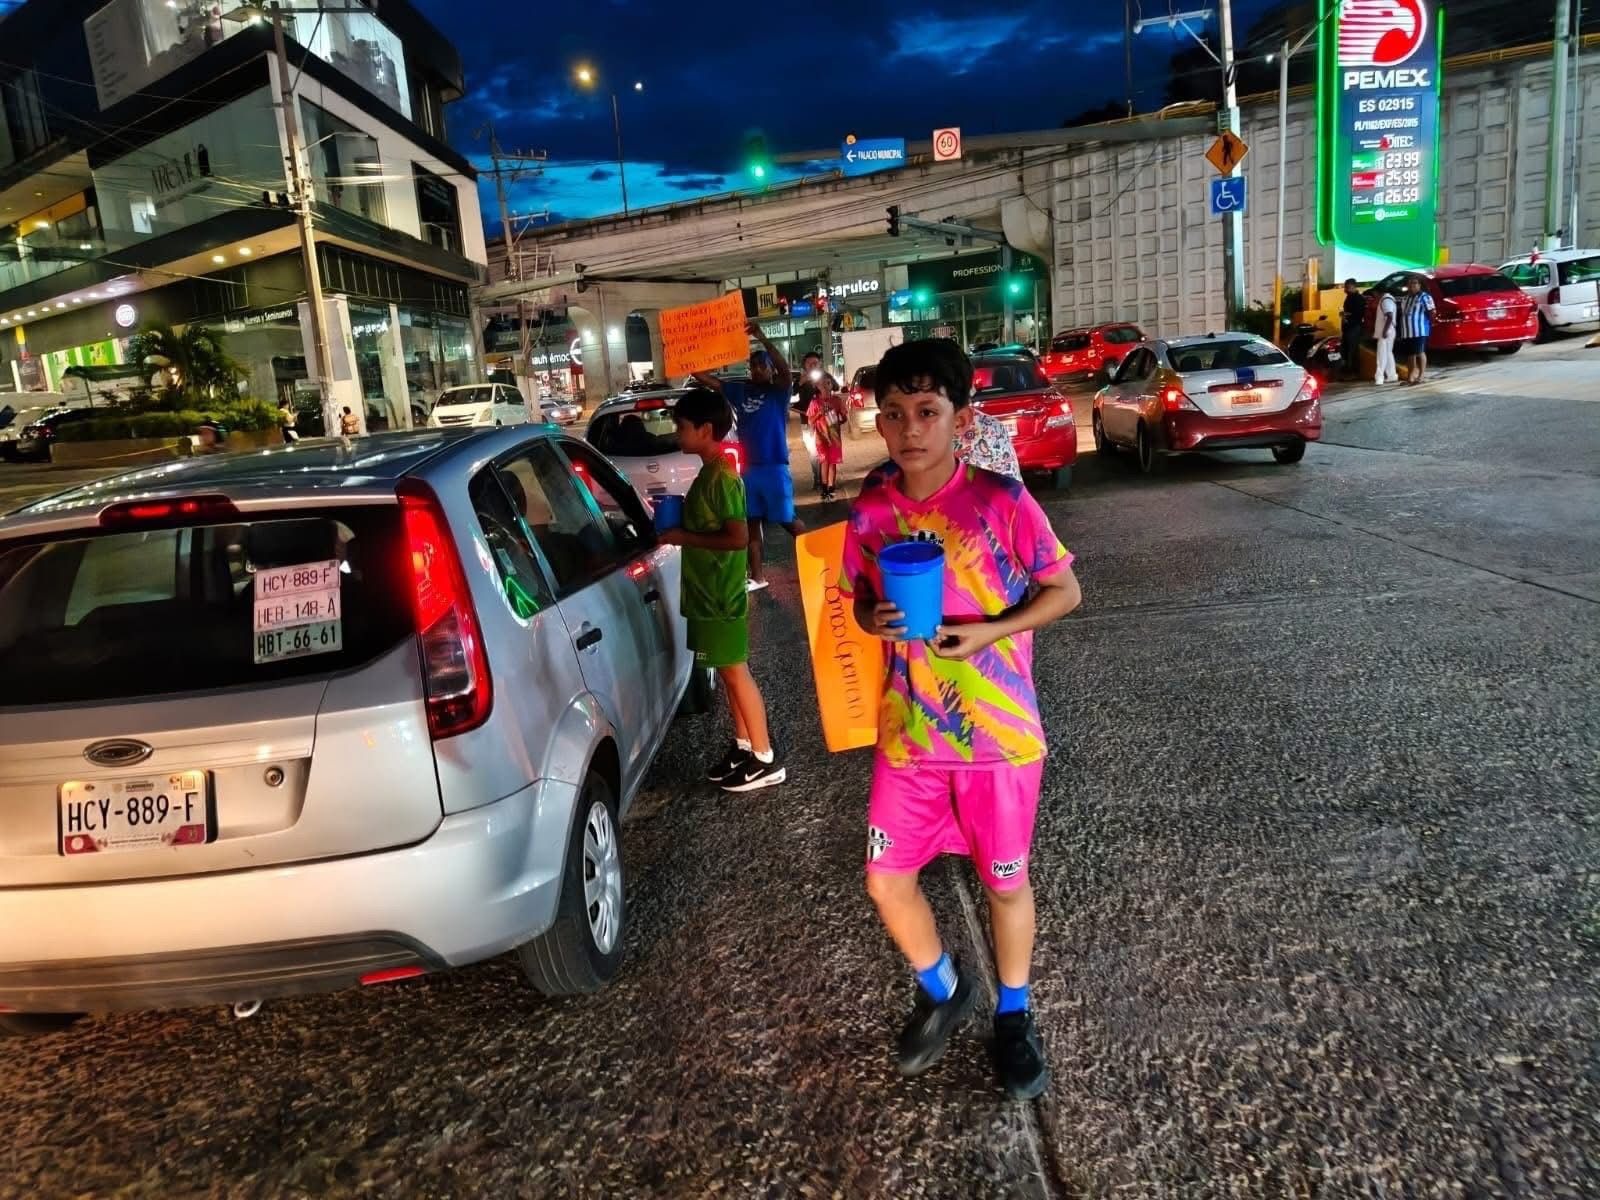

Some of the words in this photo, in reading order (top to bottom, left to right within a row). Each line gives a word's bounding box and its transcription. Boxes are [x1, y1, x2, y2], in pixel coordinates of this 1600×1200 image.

[1344, 68, 1431, 90] PEMEX
[1359, 99, 1376, 113] ES
[1378, 97, 1415, 111] 02915
[940, 136, 953, 148] 60
[858, 151, 877, 160] PALACIO
[878, 149, 903, 159] MUNICIPAL
[953, 264, 1009, 277] PROFESSION
[760, 292, 774, 310] FIAT
[263, 567, 332, 593] HCY-889-F
[257, 624, 336, 656] HBT-66-61
[67, 792, 199, 833] HCY-889-F
